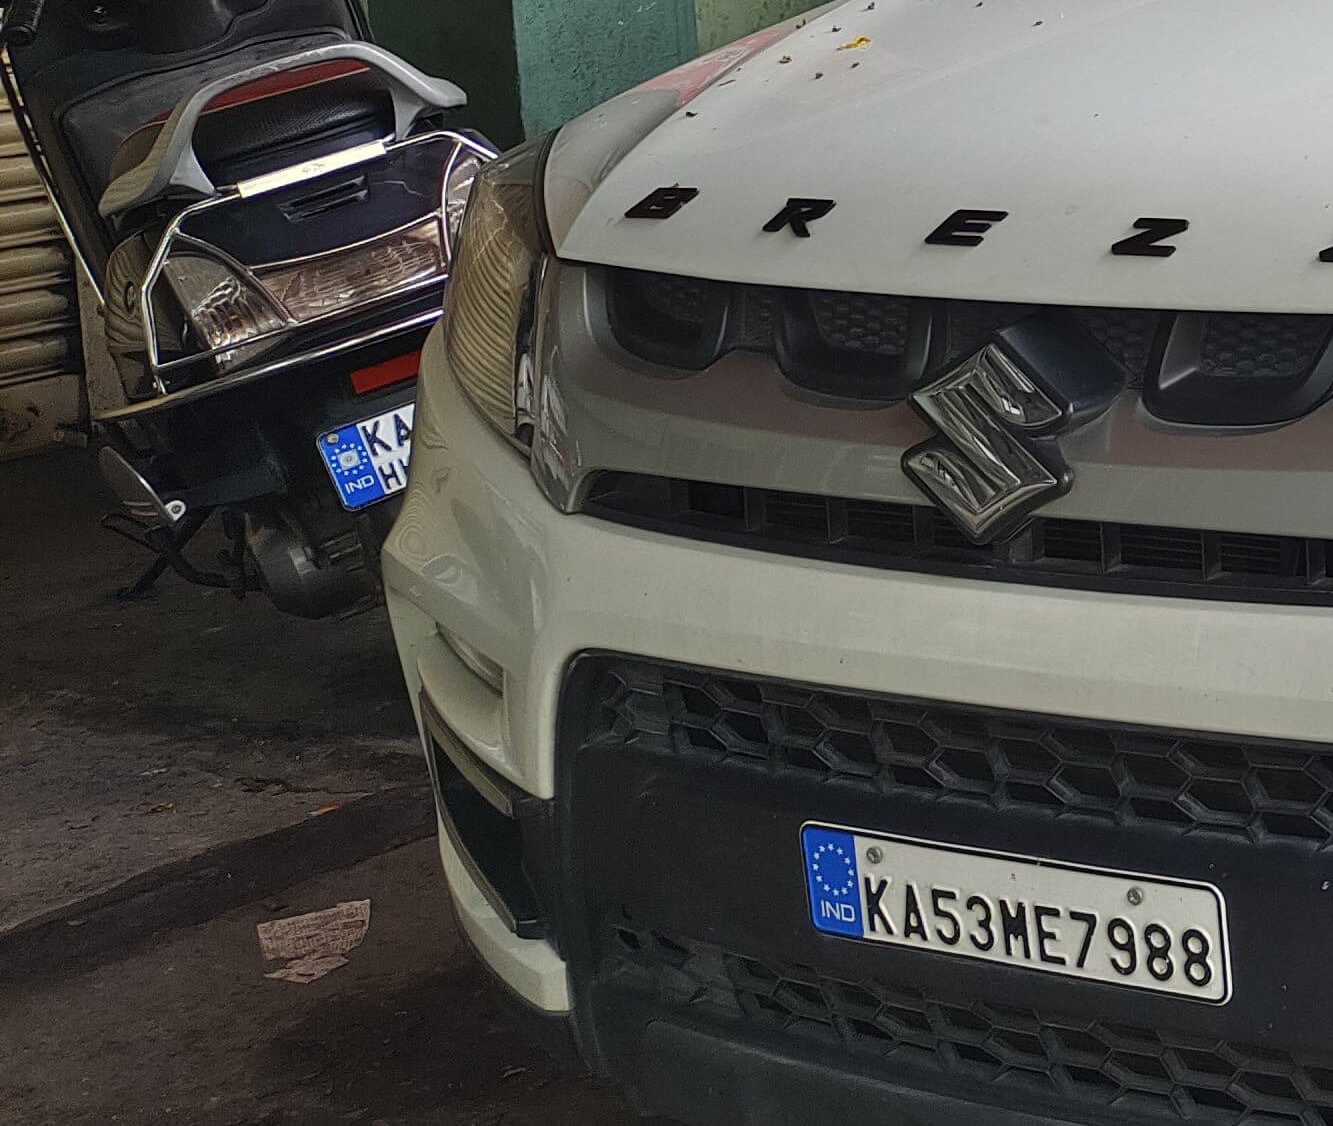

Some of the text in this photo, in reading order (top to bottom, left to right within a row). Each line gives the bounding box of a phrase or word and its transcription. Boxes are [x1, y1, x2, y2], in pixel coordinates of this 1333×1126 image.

[361, 412, 413, 457] KA
[345, 474, 375, 495] IND
[820, 899, 857, 923] IND
[864, 874, 1213, 987] KA53ME7988
